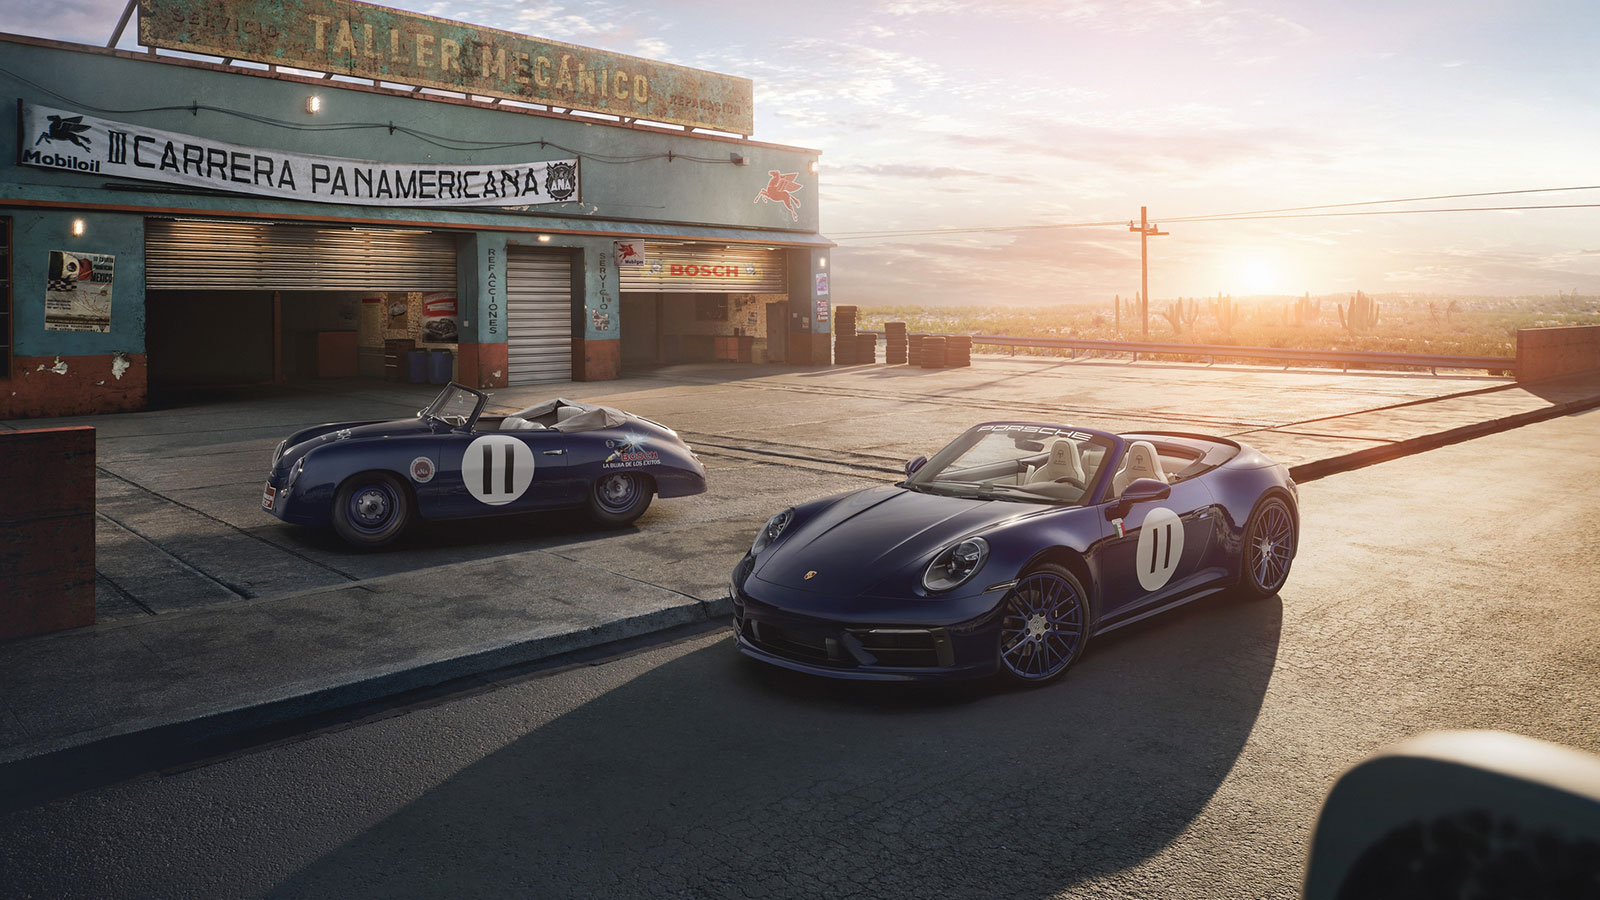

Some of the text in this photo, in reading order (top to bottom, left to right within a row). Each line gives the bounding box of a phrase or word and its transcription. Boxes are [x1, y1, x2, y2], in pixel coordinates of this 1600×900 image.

[307, 13, 649, 103] TALLER MECÁNICO
[22, 149, 100, 172] Mobiloil
[108, 130, 539, 198] III CARRERA PANAMERICANA
[550, 178, 572, 191] ANA
[487, 248, 499, 335] REFACCIONES
[599, 252, 608, 310] SERVICIO
[670, 264, 739, 277] BOSCH
[621, 452, 658, 461] BOSCH
[976, 425, 1094, 441] PORSCHE
[482, 444, 515, 495] 11
[1150, 523, 1172, 574] 11
